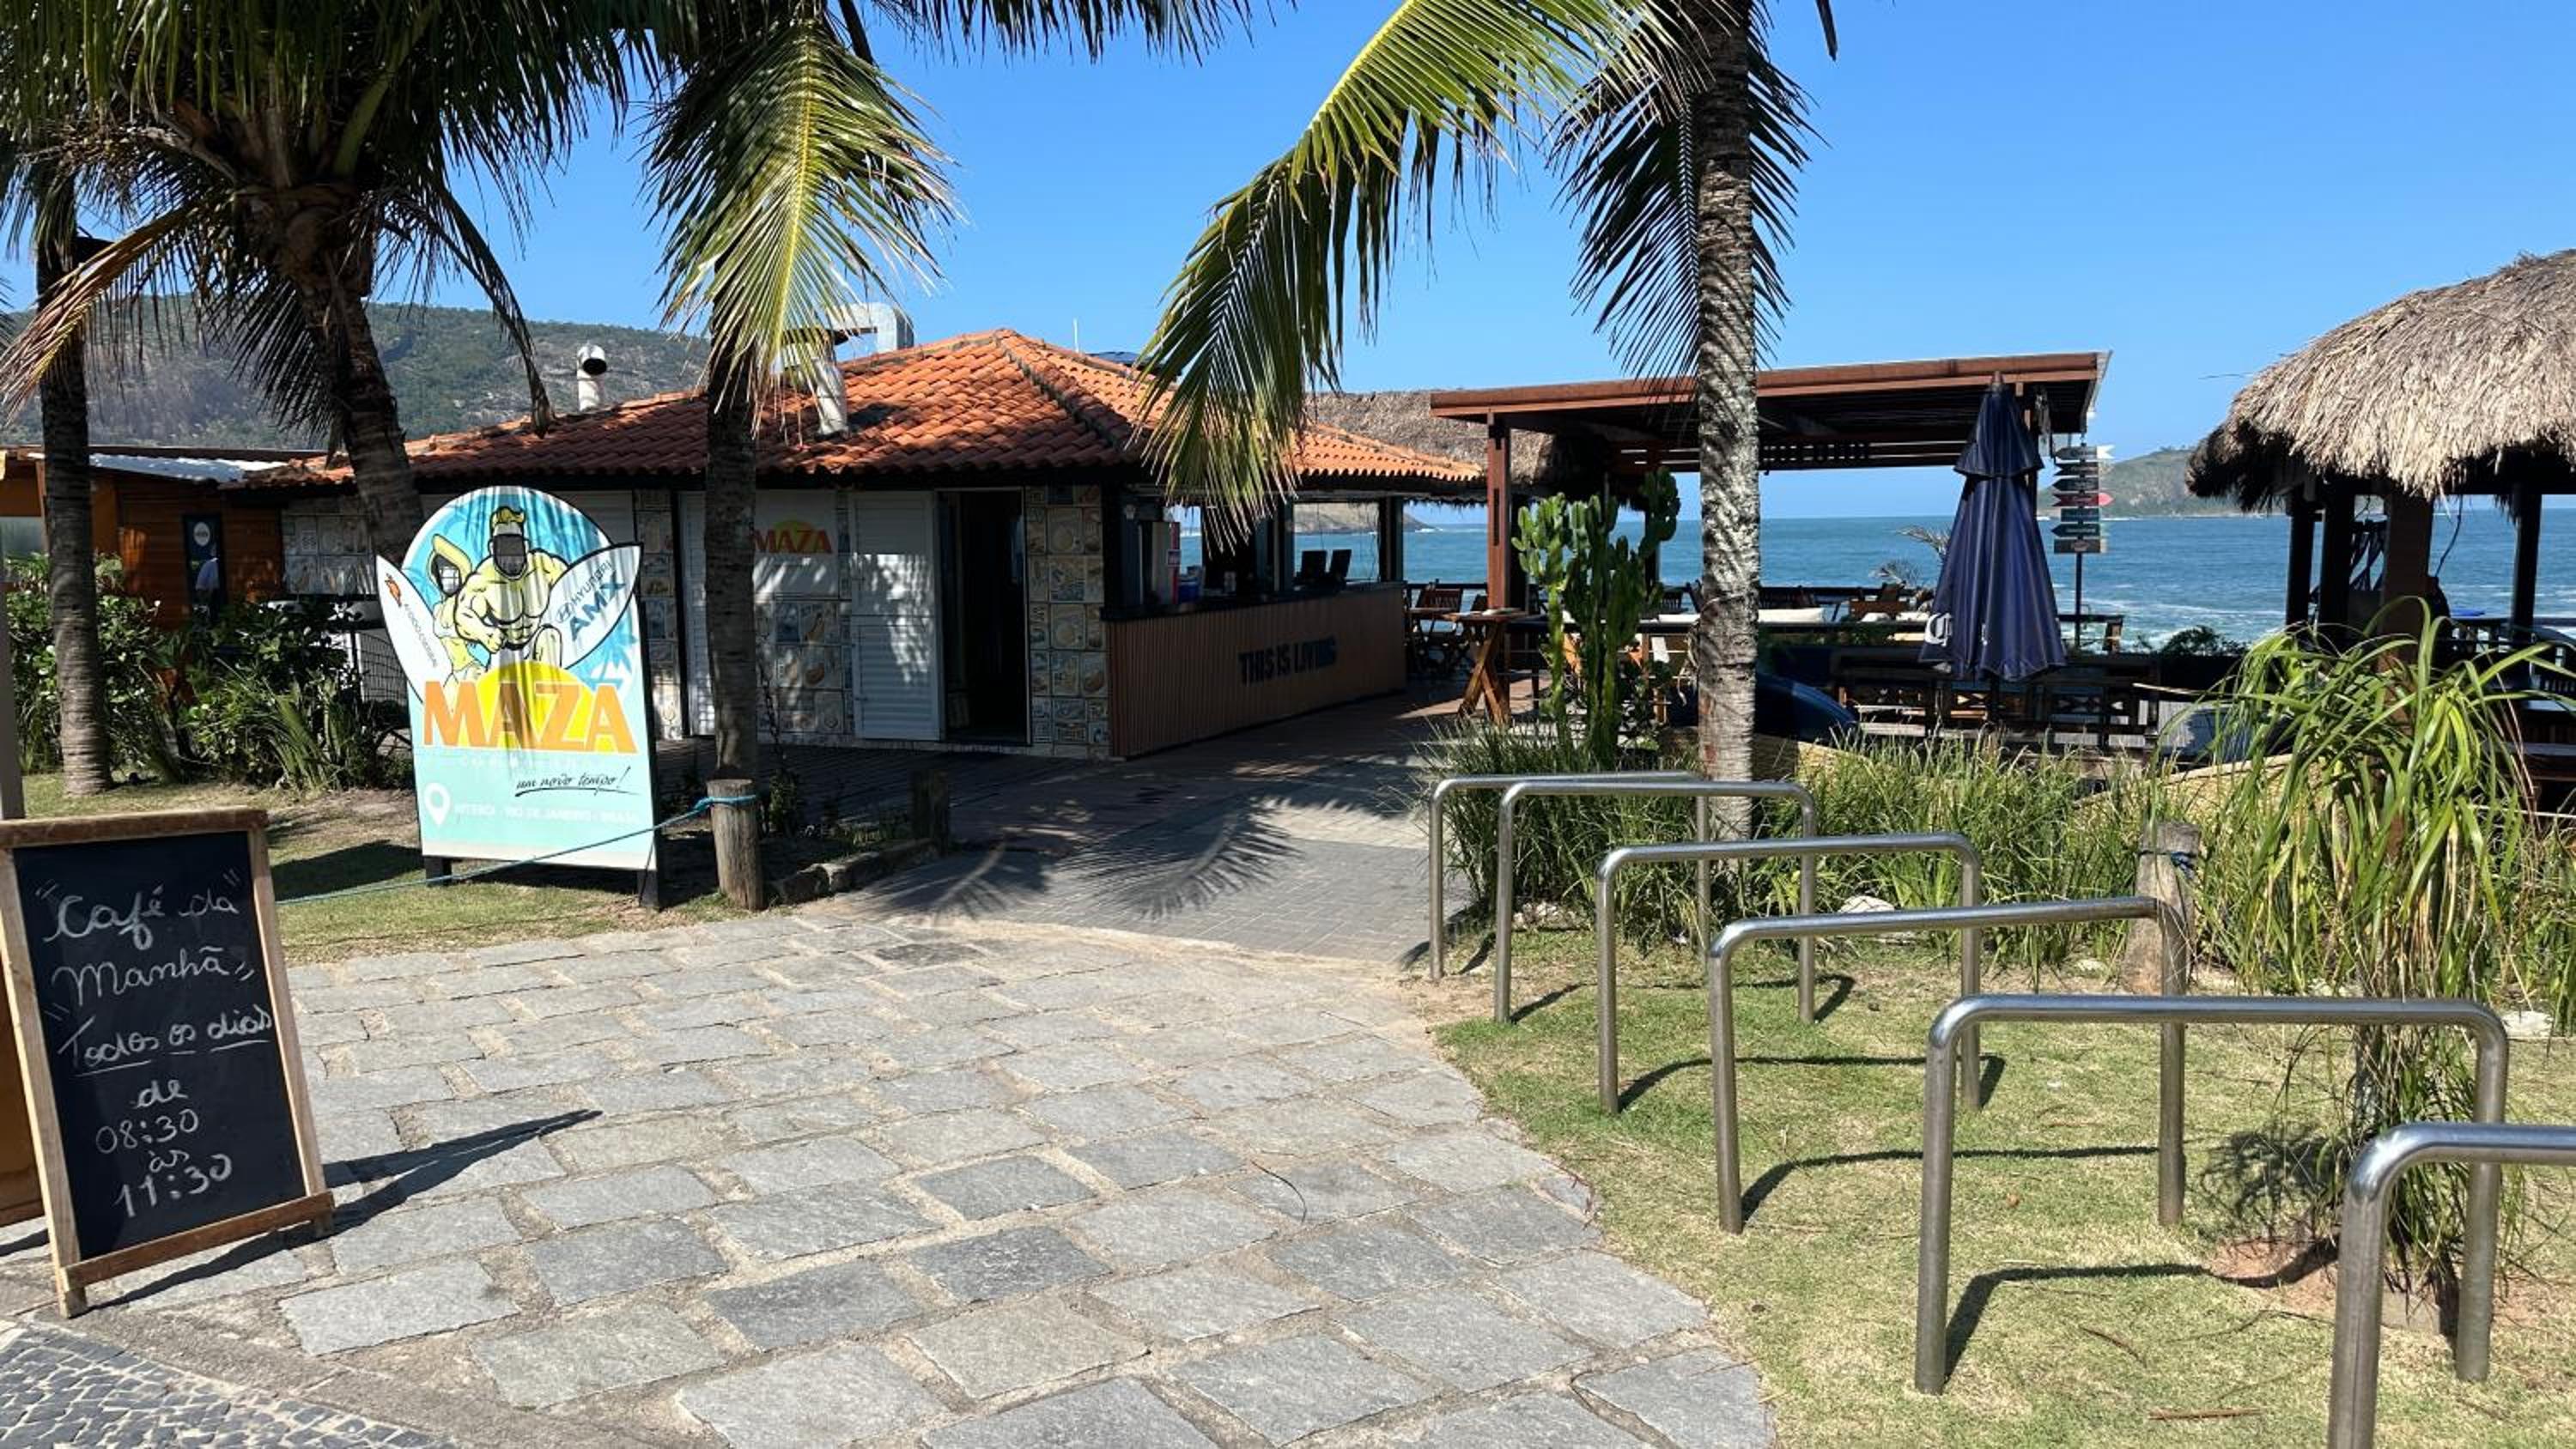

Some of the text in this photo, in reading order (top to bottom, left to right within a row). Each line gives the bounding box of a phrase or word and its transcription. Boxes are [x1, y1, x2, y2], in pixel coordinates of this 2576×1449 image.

[753, 526, 832, 554] MAZA
[570, 569, 627, 642] AMX
[1237, 647, 1275, 685] THIS
[1276, 644, 1291, 676] IS
[423, 680, 638, 754] MAZA
[168, 1024, 197, 1046] os
[207, 1003, 273, 1040] dias
[133, 1079, 190, 1109] de
[95, 1108, 200, 1155] 08:30
[112, 1153, 233, 1218] 11:30
